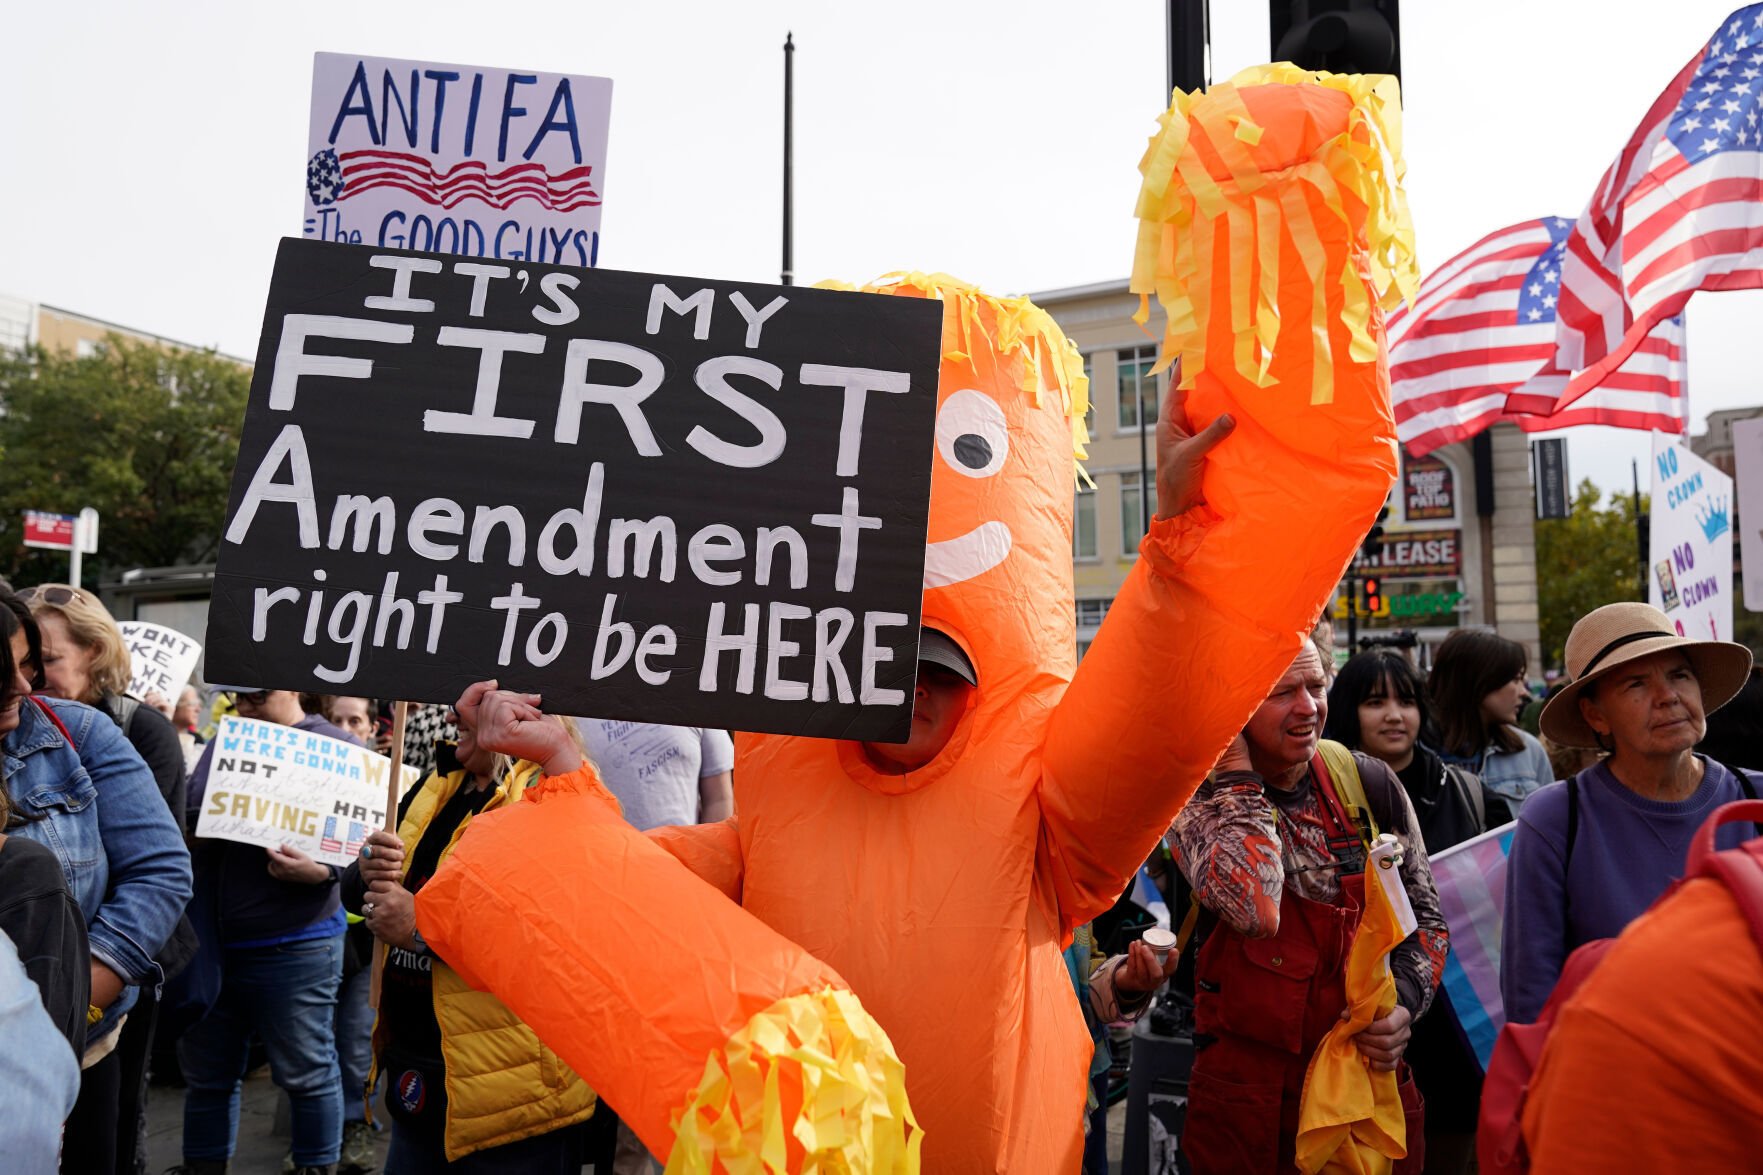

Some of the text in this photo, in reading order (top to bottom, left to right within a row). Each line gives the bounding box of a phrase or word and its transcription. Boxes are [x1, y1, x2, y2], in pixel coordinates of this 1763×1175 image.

[328, 60, 582, 164] ANTIFA
[379, 210, 485, 257] GOOD
[364, 254, 790, 349] IT'S MY
[269, 313, 911, 477] FIRST
[1657, 447, 1679, 482] NO
[225, 424, 883, 593] Amendment
[1409, 492, 1449, 508] PATIO
[1667, 470, 1704, 510] CROWN
[1382, 540, 1456, 567] LEASE
[1673, 542, 1694, 575] NO
[1682, 576, 1719, 609] CLOWN
[252, 569, 909, 706] right to be HERE
[293, 750, 360, 780] GONNA
[306, 737, 349, 759] HOW
[217, 758, 277, 779] NOT
[209, 791, 319, 837] SAVING
